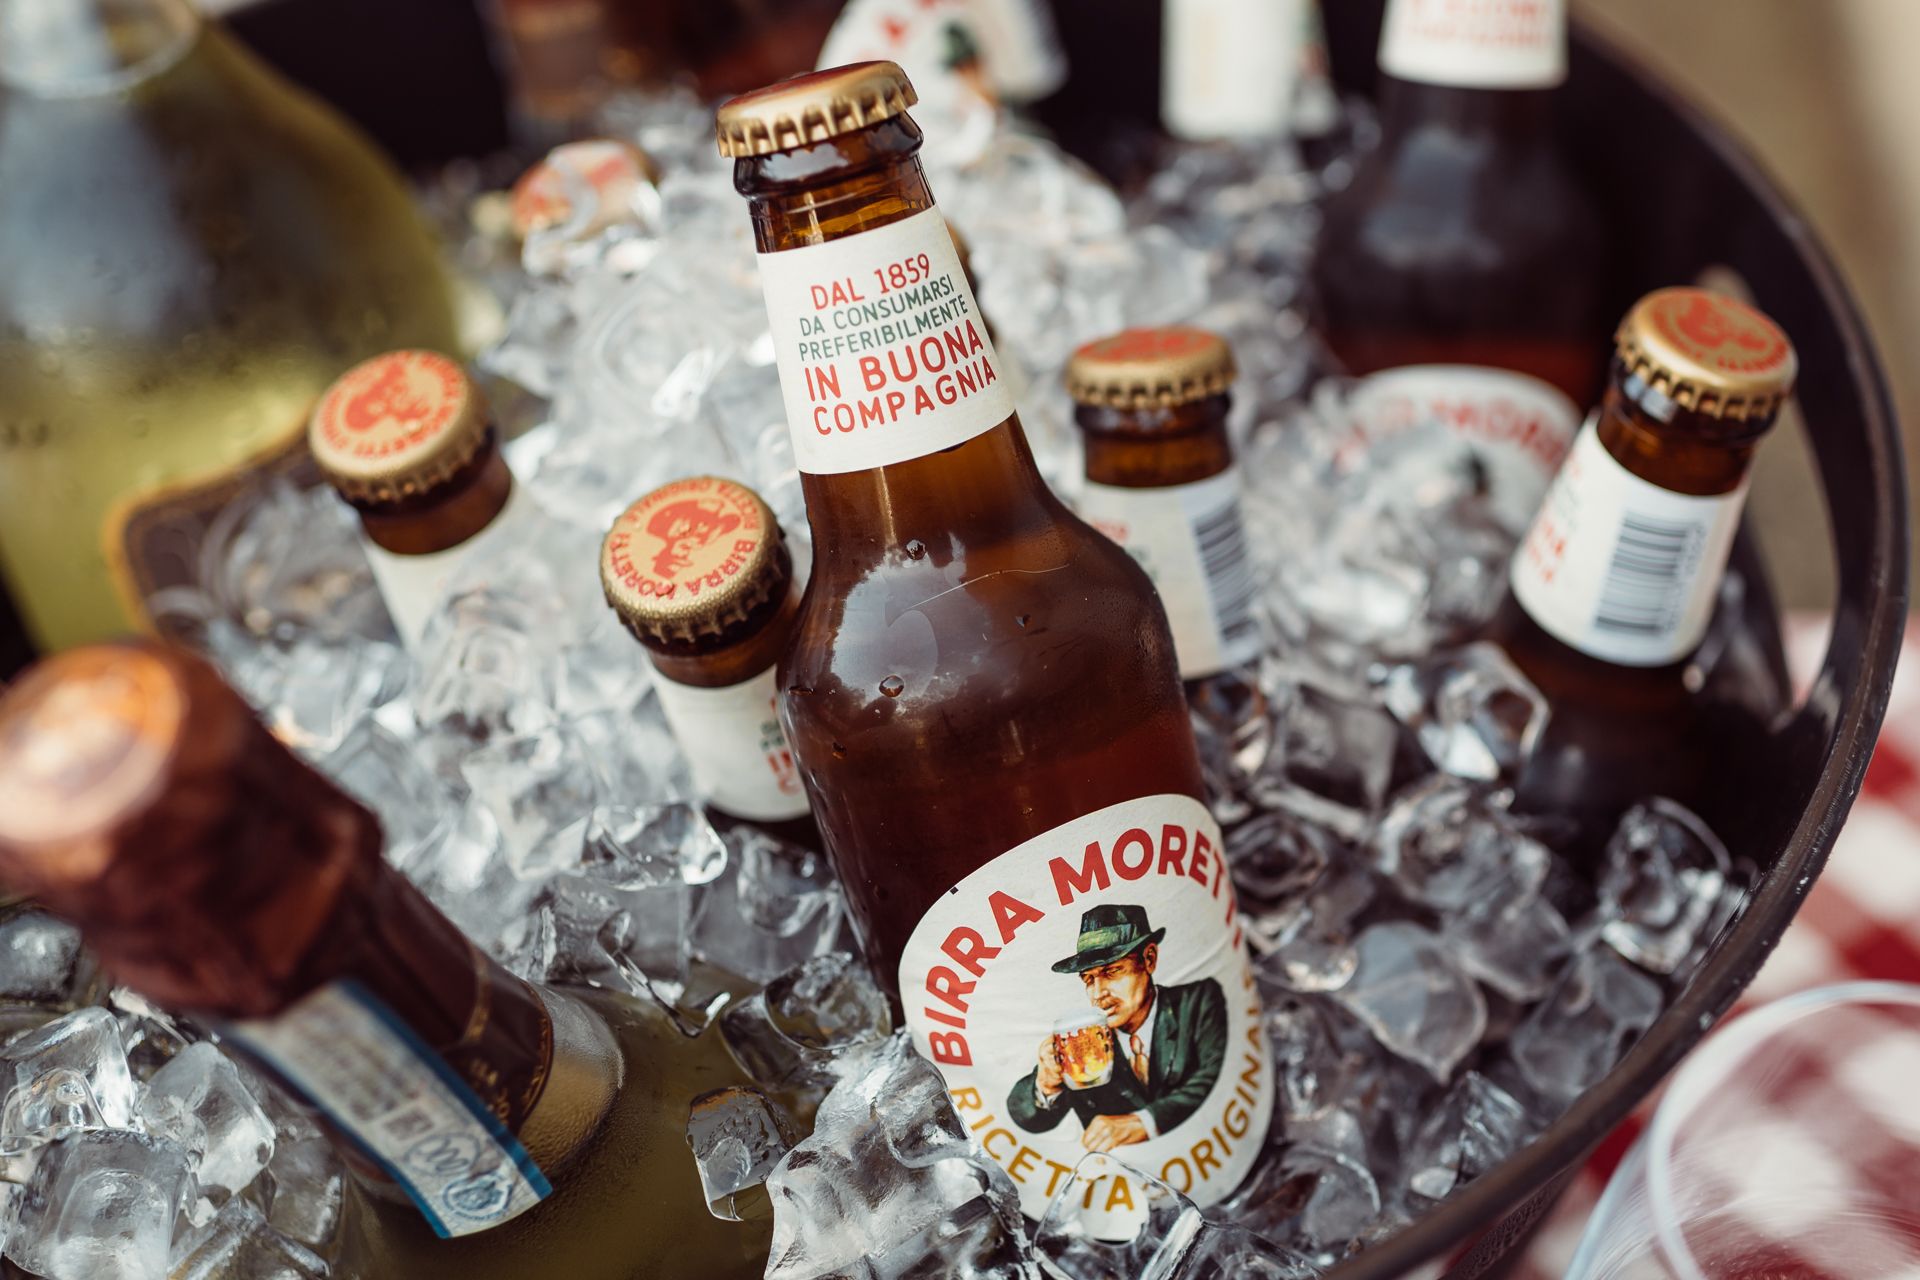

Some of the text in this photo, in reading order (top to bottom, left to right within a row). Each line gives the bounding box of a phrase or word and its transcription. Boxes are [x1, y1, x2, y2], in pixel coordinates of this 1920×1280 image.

[800, 273, 955, 337] DA CONSUMARSI
[811, 252, 931, 311] DAL 1859
[798, 294, 968, 362] PREFERIBILMENTE
[804, 318, 985, 402] IN BUONA
[813, 354, 997, 436] COMPAGNIA
[684, 539, 757, 596] BIRRA
[924, 889, 1046, 1067] BIRRA
